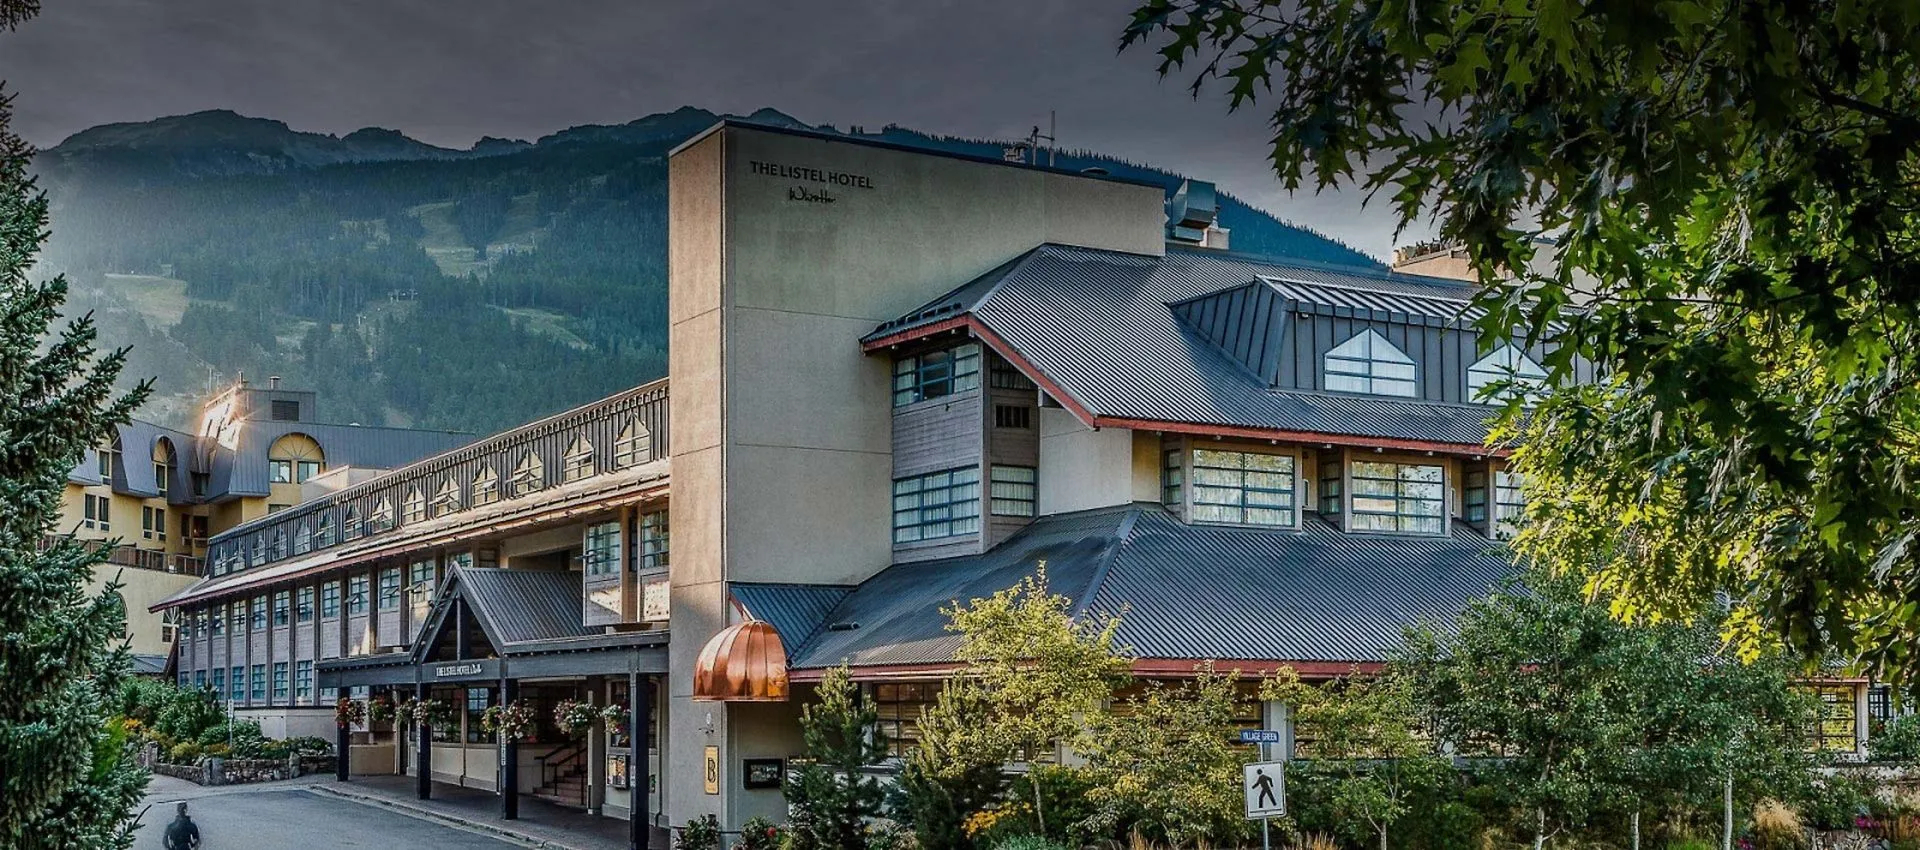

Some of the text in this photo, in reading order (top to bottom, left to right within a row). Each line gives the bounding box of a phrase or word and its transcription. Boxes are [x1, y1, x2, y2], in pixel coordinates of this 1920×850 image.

[750, 161, 874, 189] THE LISTEL HOTEL
[1242, 731, 1278, 740] VILLAGE GREEN
